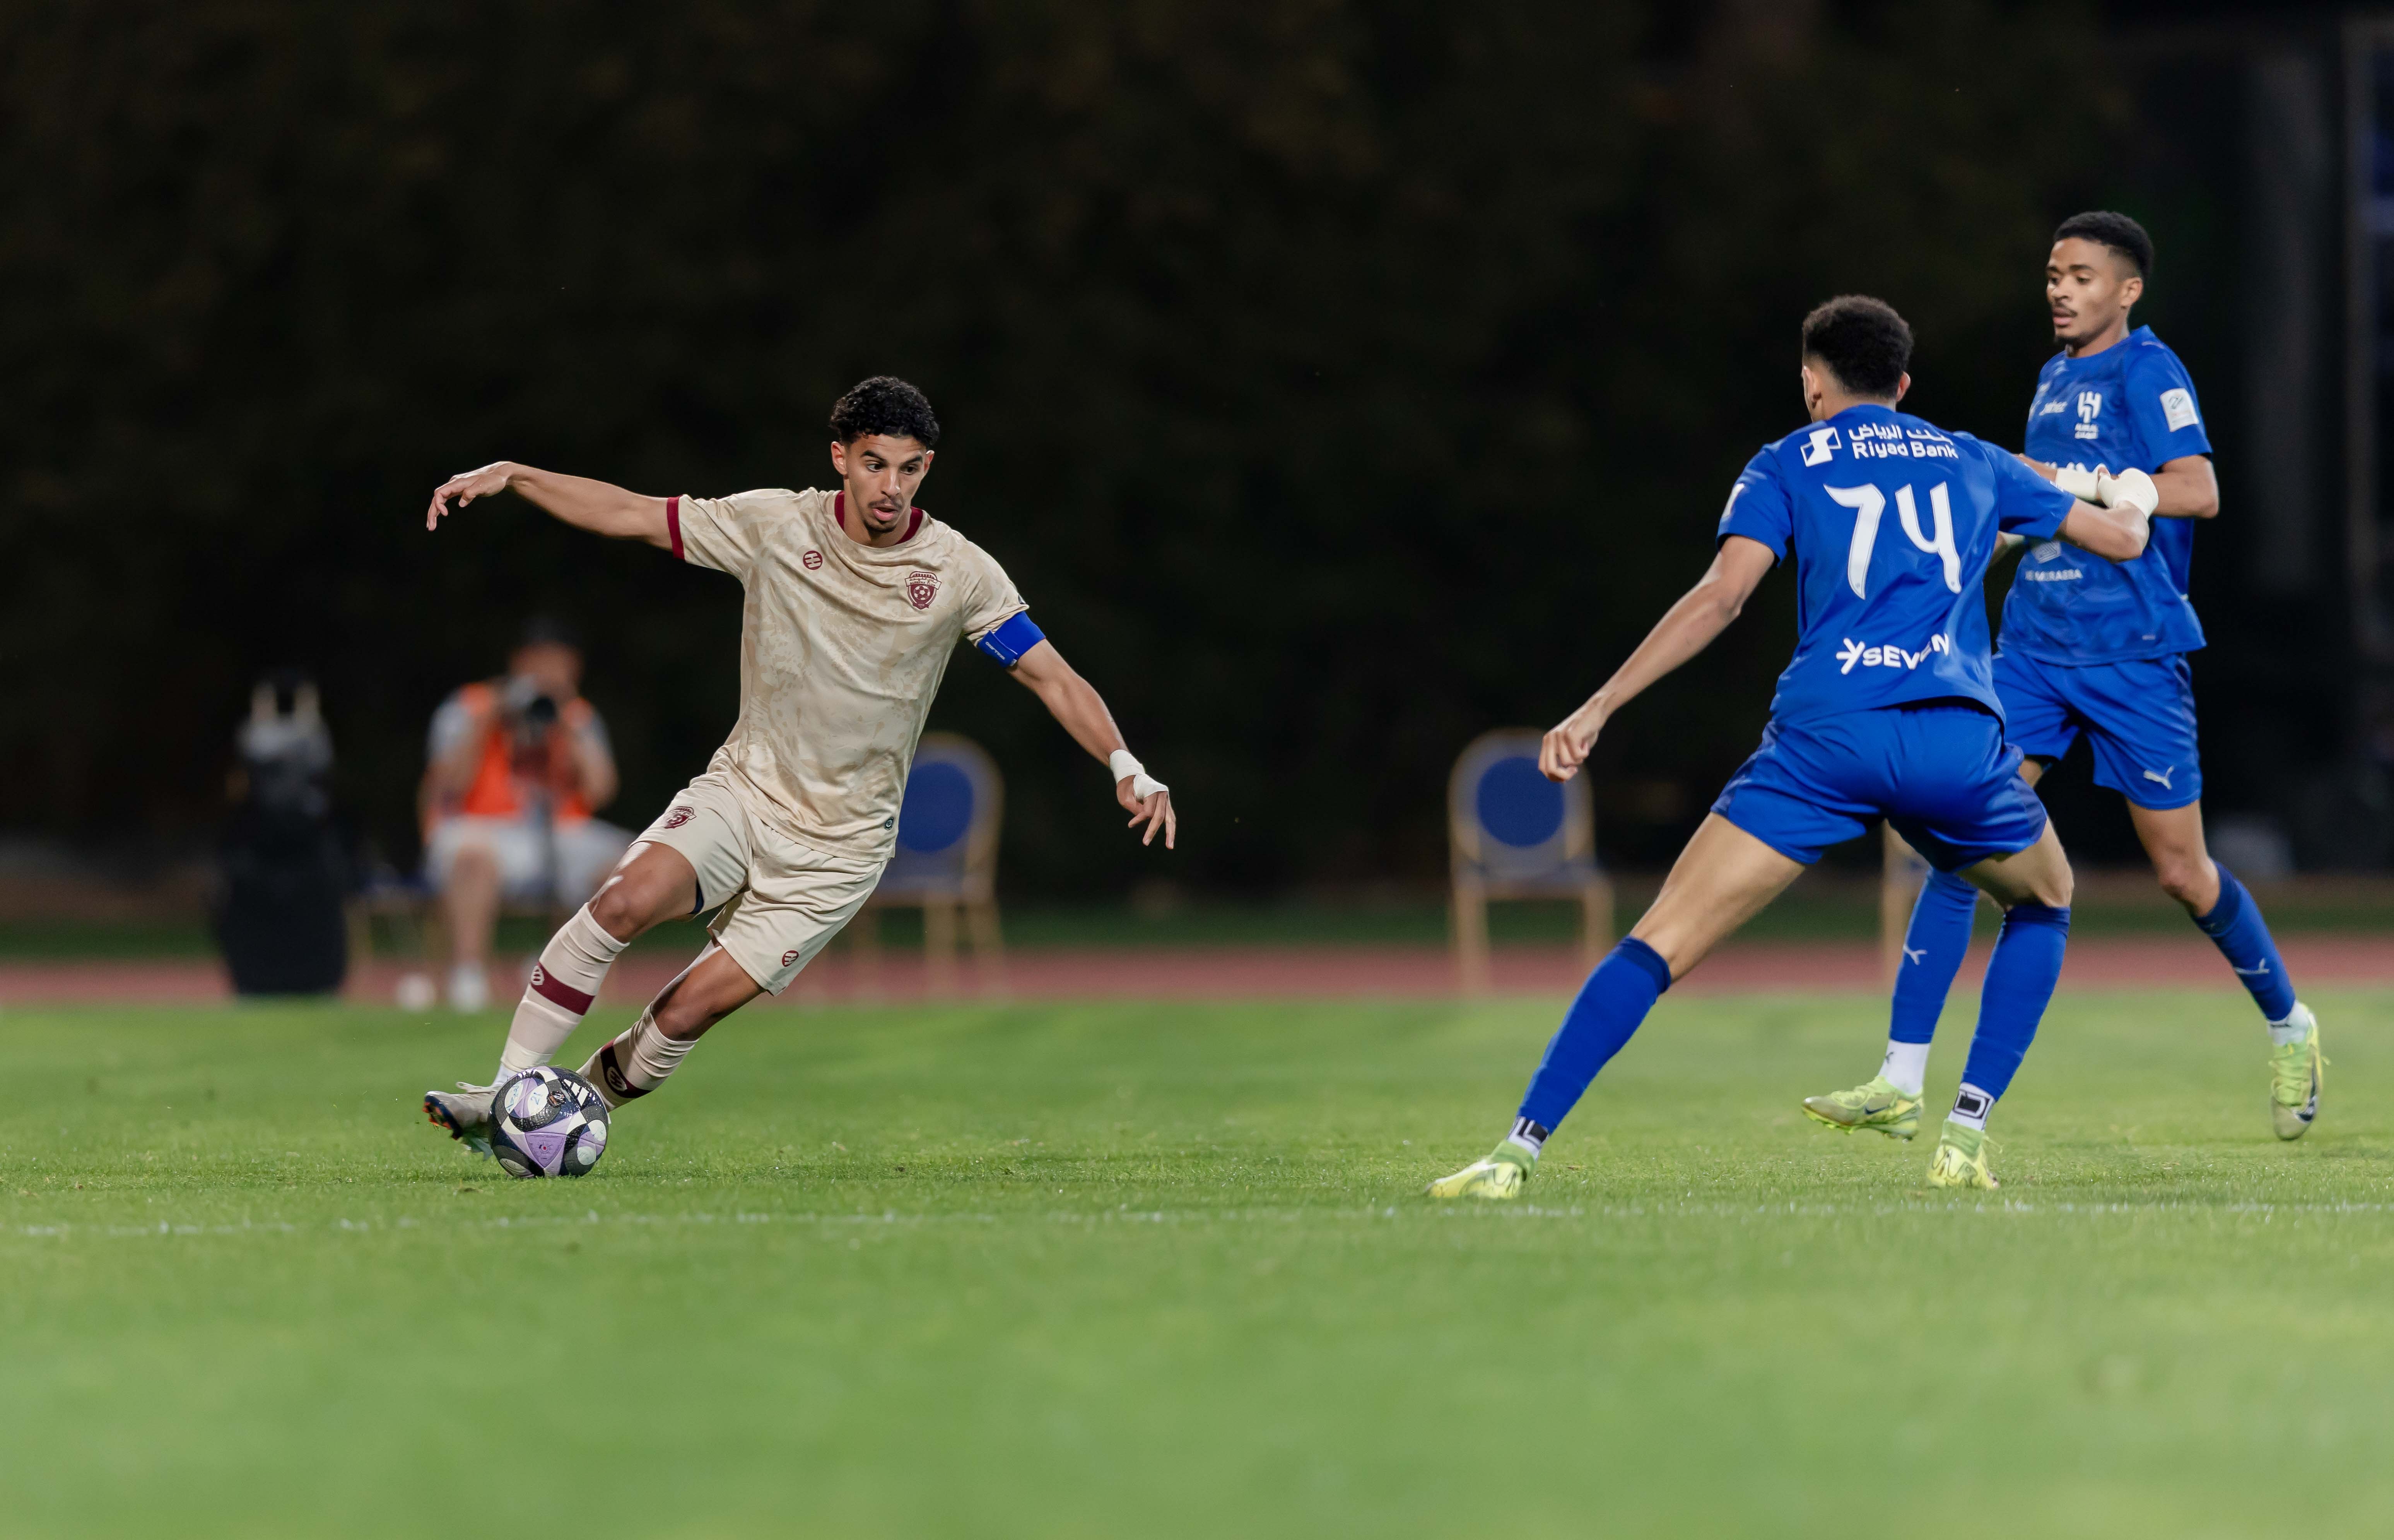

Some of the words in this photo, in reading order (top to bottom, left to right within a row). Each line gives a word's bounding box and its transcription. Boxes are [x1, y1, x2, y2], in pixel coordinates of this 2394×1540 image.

[1848, 422, 1903, 440] الرياض
[1852, 440, 1909, 459] Riyad
[1910, 440, 1959, 459] Bank
[1823, 481, 1962, 601] 74
